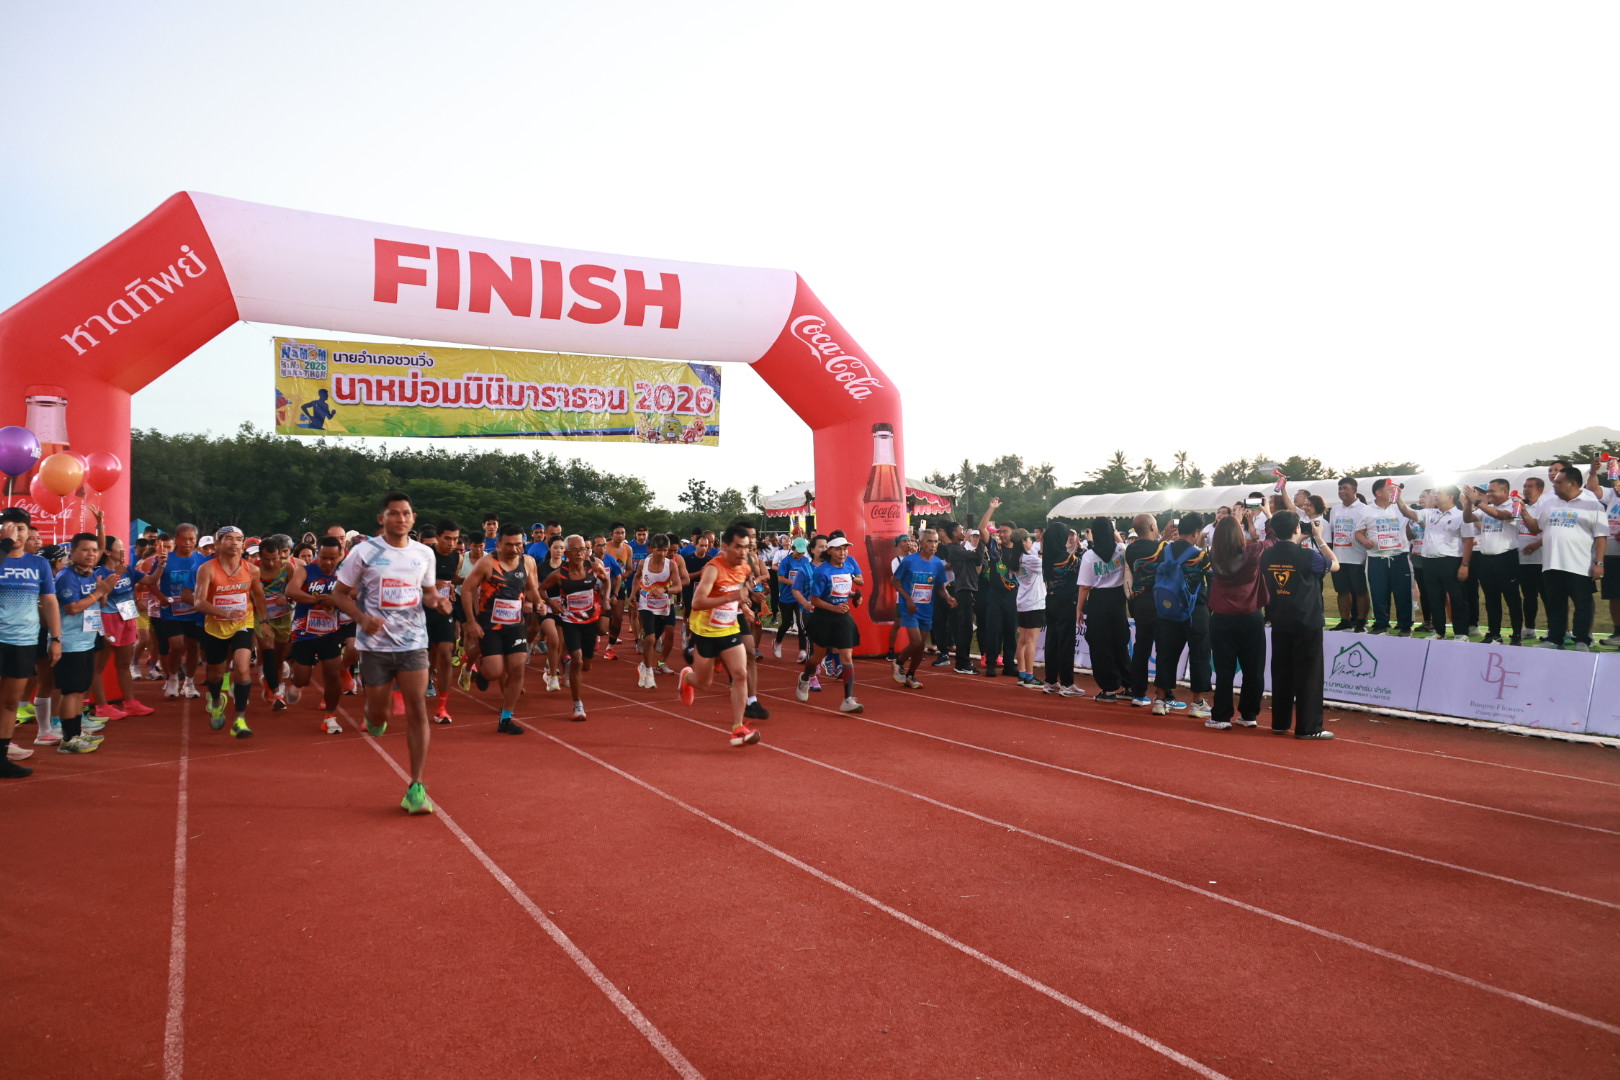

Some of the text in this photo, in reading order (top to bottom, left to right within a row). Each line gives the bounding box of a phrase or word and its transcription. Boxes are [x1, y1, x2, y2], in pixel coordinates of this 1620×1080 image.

[60, 244, 207, 356] หาดทิพย์
[373, 237, 681, 330] FINISH
[304, 361, 327, 371] 2026
[333, 350, 434, 367] นายอำเภอชวนวิ่ง
[790, 314, 885, 400] Coca-Cola
[335, 371, 714, 415] นาหม่อมมินิมาราธอน 2026
[308, 581, 325, 594] Hog
